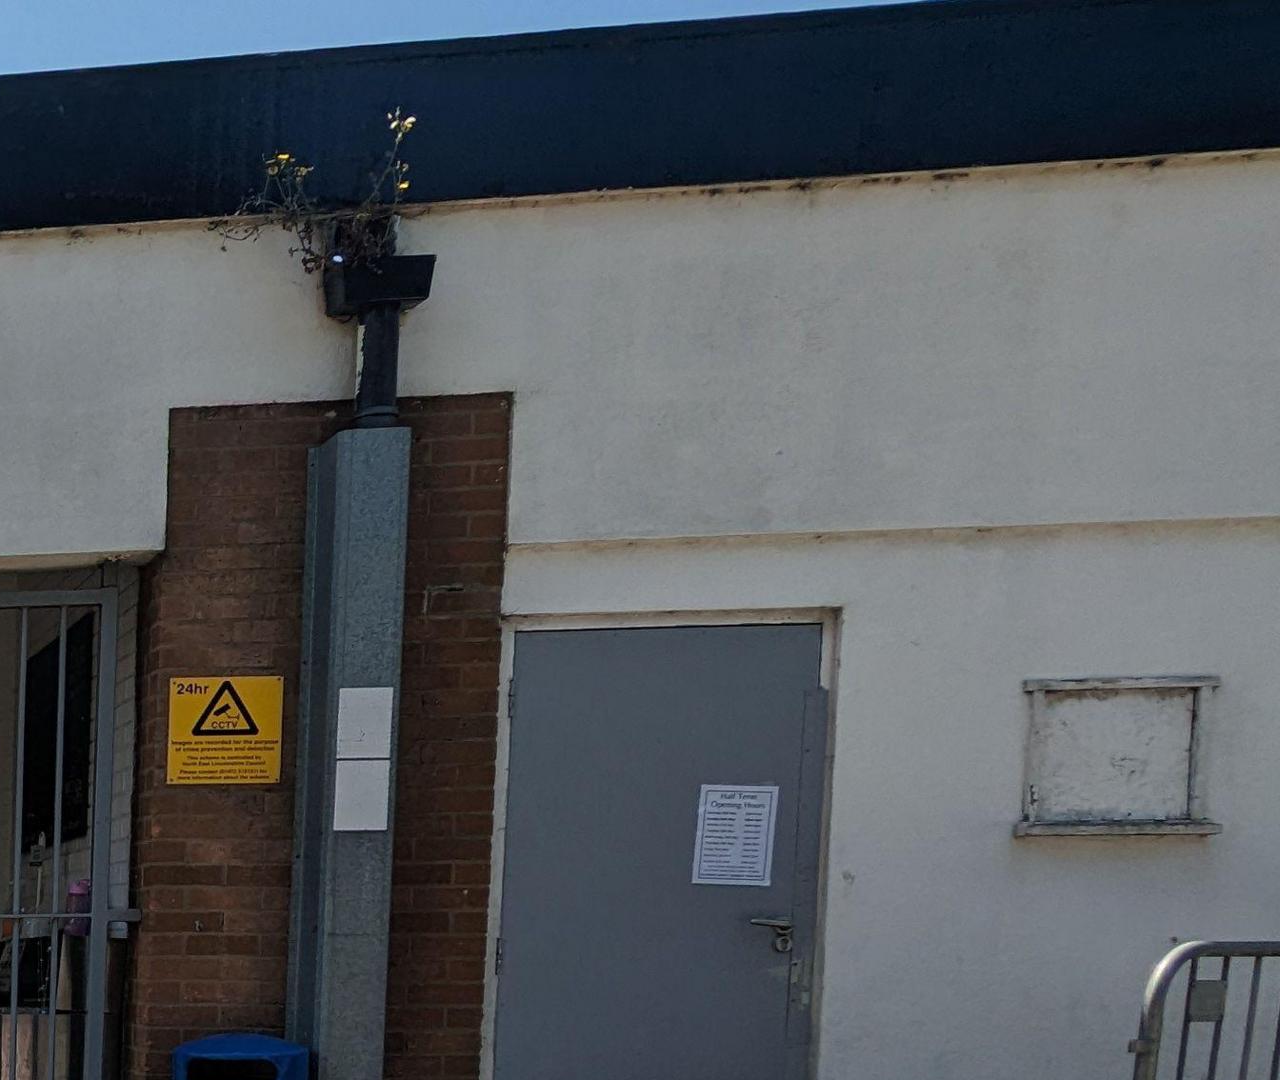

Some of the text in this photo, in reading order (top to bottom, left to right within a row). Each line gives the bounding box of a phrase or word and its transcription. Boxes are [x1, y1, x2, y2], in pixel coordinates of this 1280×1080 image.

[177, 683, 209, 695] 24hr
[211, 721, 238, 729] CCTV
[711, 800, 766, 809] Opening Hours
